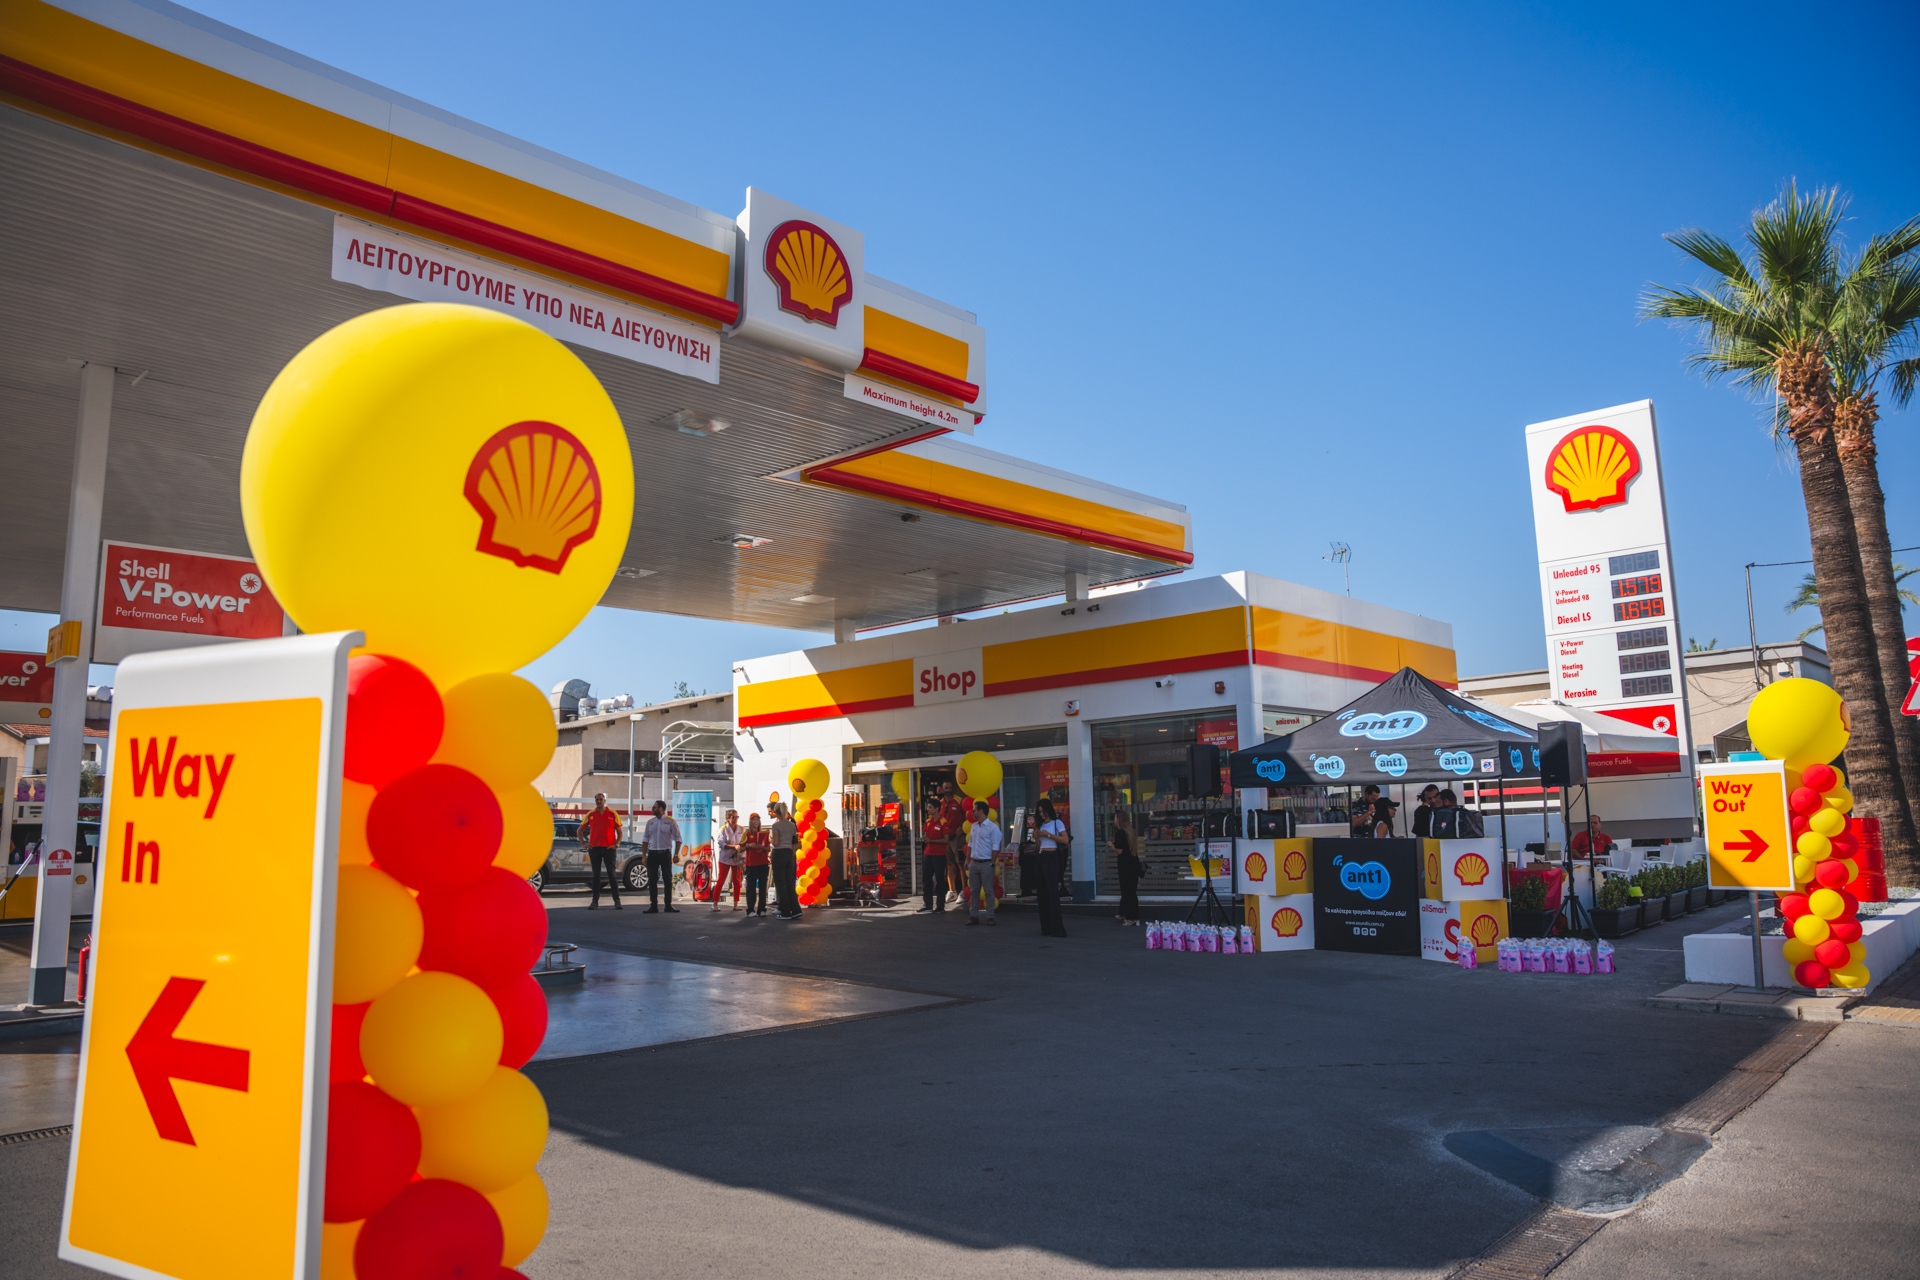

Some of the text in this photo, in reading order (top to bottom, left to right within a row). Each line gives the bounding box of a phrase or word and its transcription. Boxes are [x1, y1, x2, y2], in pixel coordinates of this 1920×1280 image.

[347, 238, 711, 364] ΛΕΙΤΟΥΡΓΟΥΜΕ ΥΠΟ ΝΕΑ ΔΙΕΥΘΥΝΣΗ
[863, 386, 959, 425] Maximum height 4.2m
[119, 559, 170, 580] Shell
[1553, 564, 1601, 580] Unleaded 95
[1555, 589, 1579, 597] V-Power
[1618, 574, 1662, 598] 1.579
[118, 577, 251, 614] V-Power
[1556, 595, 1581, 605] Unleaded
[116, 606, 205, 624] Performance Fuels
[1620, 598, 1664, 621] 1.649
[1557, 611, 1592, 625] Diesel LS
[1560, 640, 1584, 648] V-Power
[1561, 647, 1577, 656] Diesel
[1562, 662, 1583, 671] Heating
[920, 665, 976, 696] Shop
[1562, 670, 1580, 679] Diesel
[1564, 687, 1597, 699] Kerosine
[1352, 717, 1415, 731] ant1
[1260, 763, 1281, 773] ant1
[1318, 760, 1340, 770] ant1
[1379, 757, 1402, 768] ant1
[1444, 756, 1468, 766] ant1
[1614, 757, 1632, 765] Fuels
[130, 736, 236, 819] Way
[1711, 780, 1753, 798] Way
[1713, 798, 1746, 813] Out
[121, 821, 160, 884] In
[1347, 869, 1382, 884] ant1
